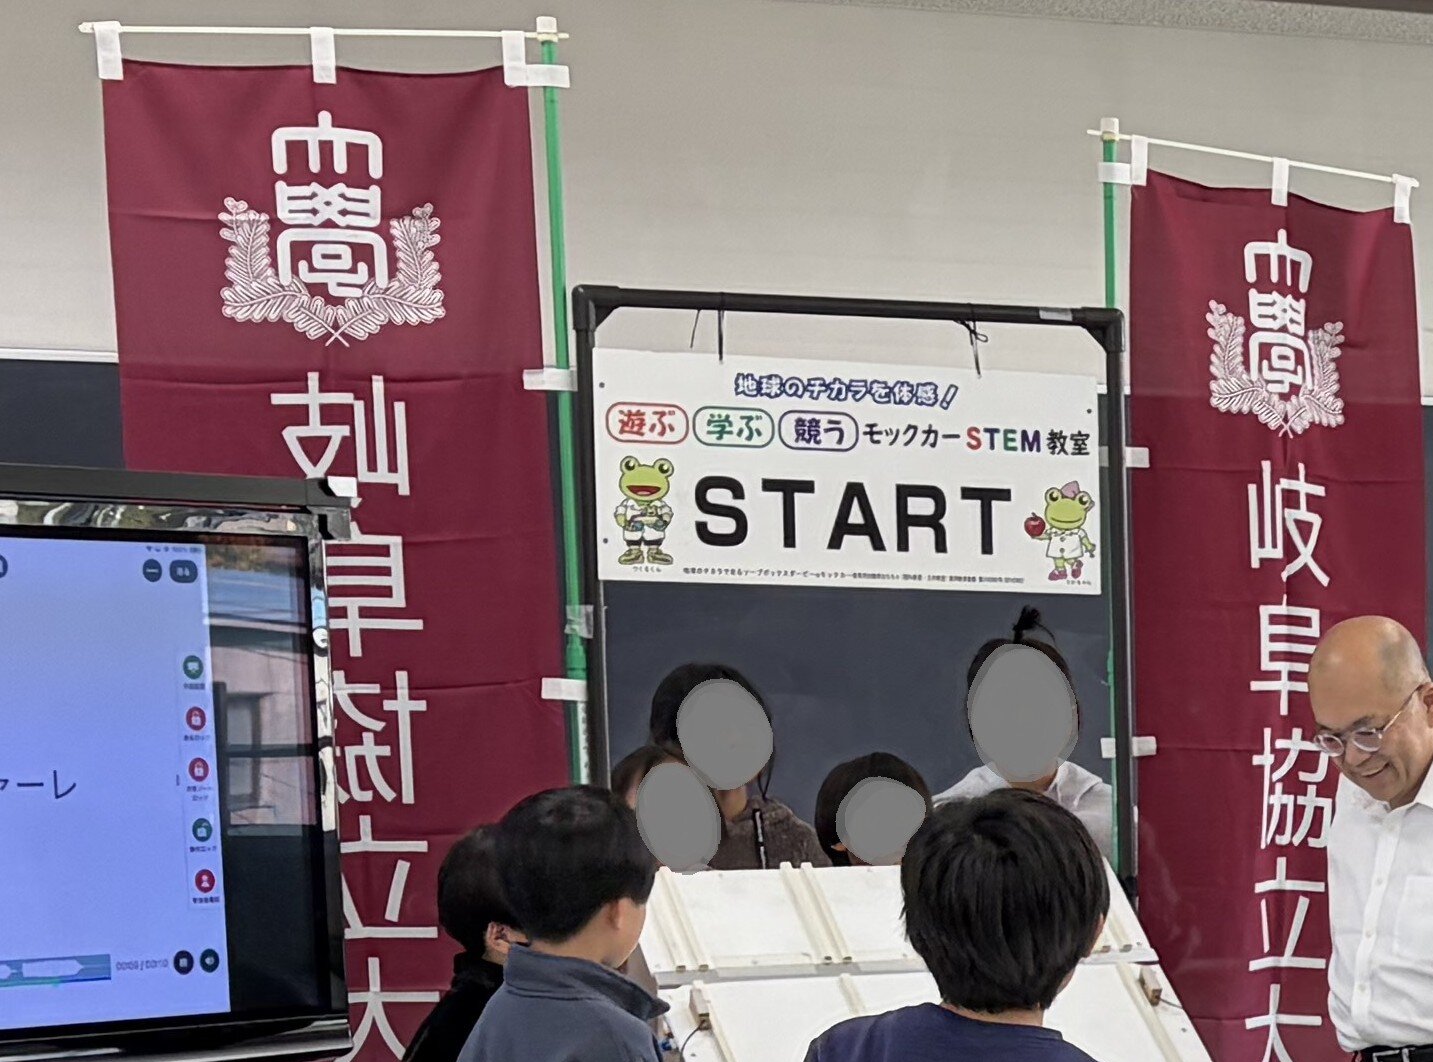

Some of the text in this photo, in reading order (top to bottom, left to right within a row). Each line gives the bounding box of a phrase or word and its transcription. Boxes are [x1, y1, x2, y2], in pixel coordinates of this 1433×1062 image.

[618, 409, 676, 438] 遊ぶ
[706, 413, 763, 441] 学ぶ
[794, 416, 846, 445] 競う
[694, 475, 1012, 556] START
